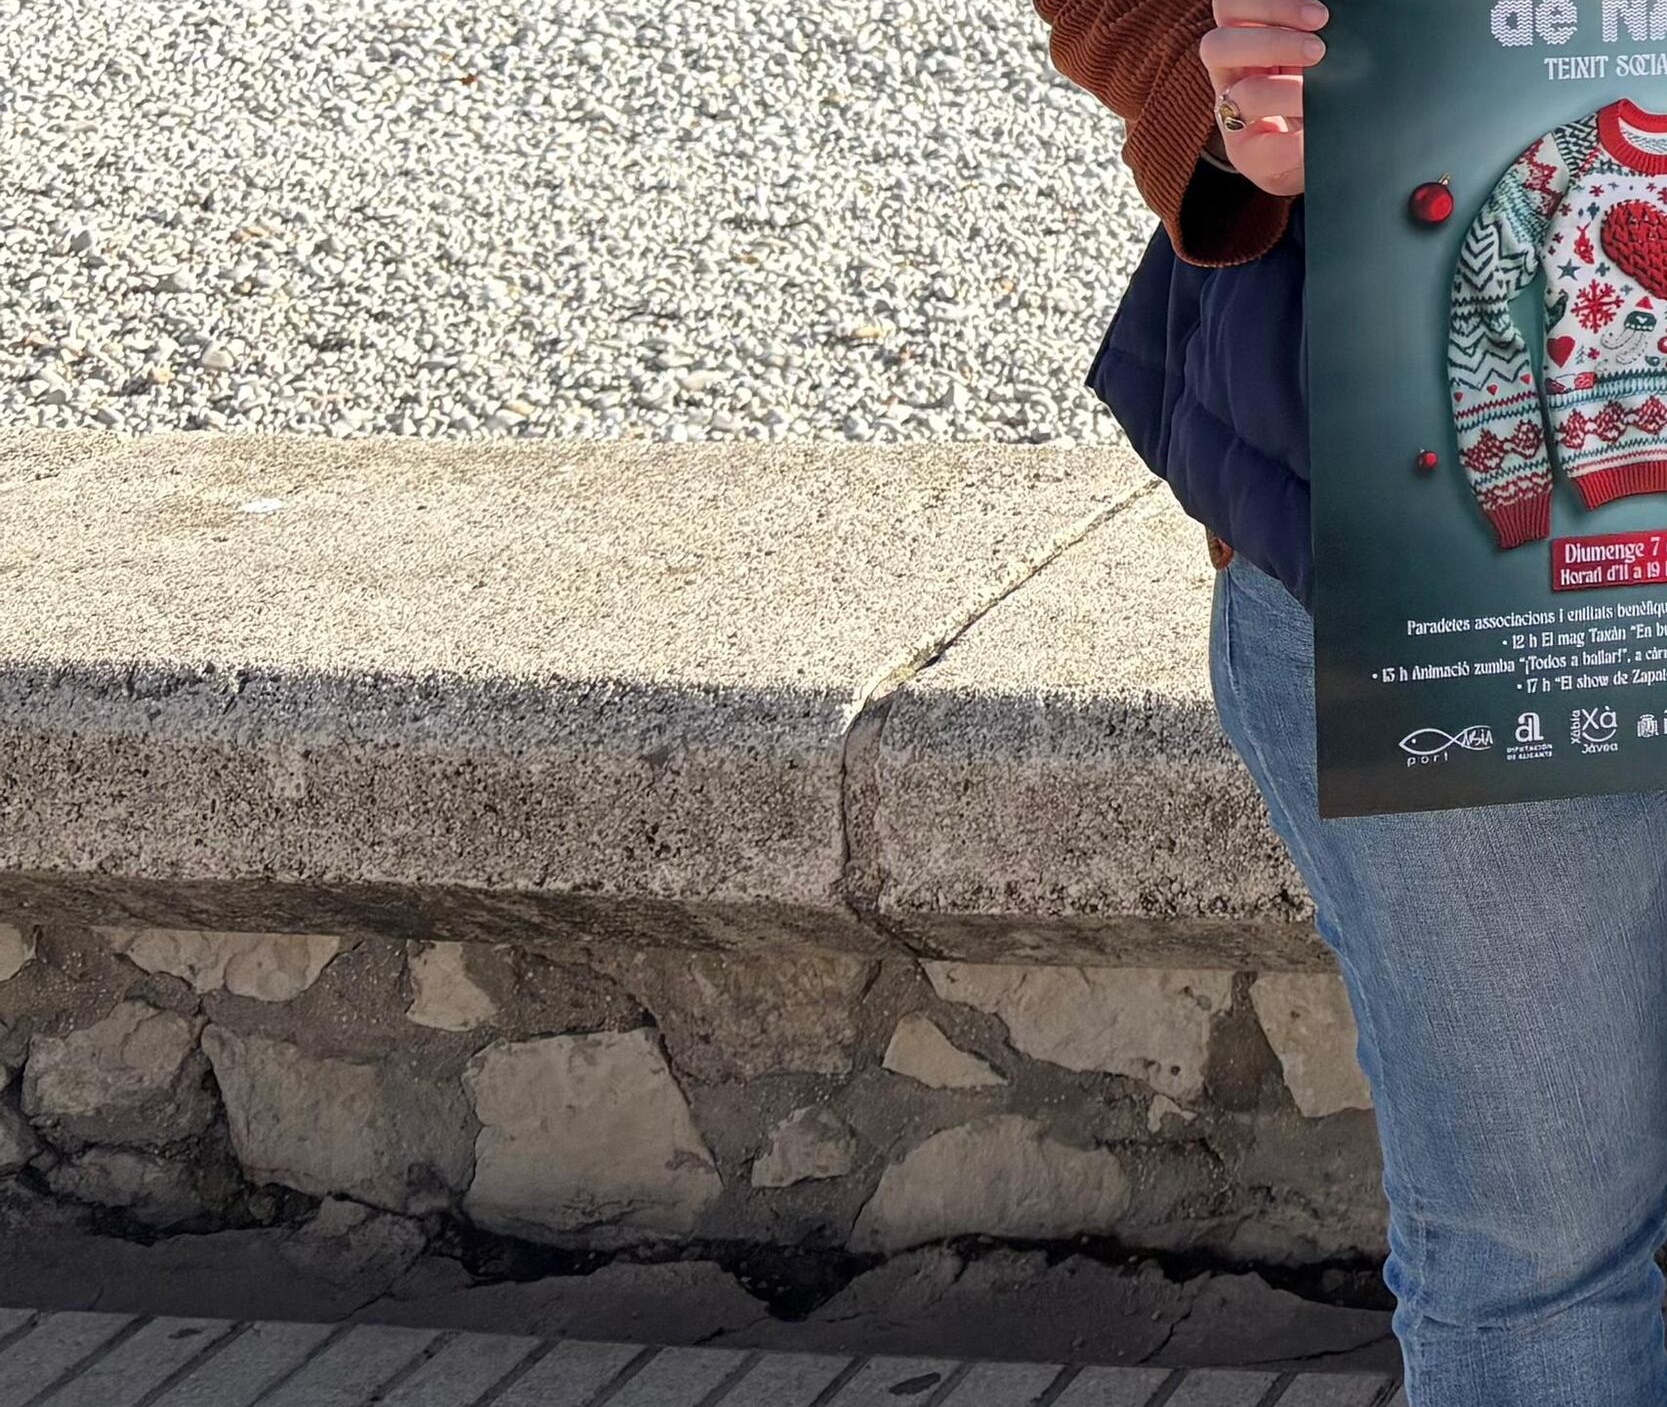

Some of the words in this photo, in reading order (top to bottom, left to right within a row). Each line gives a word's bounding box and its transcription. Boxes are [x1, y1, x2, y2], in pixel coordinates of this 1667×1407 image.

[1544, 55, 1609, 80] TEIXIT
[1564, 542, 1645, 564] Diumenge
[1650, 536, 1661, 556] 7
[1633, 565, 1642, 580] a
[1647, 561, 1660, 578] 19
[1406, 617, 1471, 636] Paradetes
[1475, 610, 1556, 631] associacions
[1567, 604, 1613, 623] entitats
[1512, 634, 1525, 650] 12
[1528, 632, 1538, 648] h
[1541, 631, 1554, 647] El
[1557, 630, 1585, 648] mag
[1399, 666, 1408, 682] h
[1412, 660, 1470, 681] Animació
[1474, 657, 1516, 675] zumba
[1570, 655, 1579, 667] a
[1634, 649, 1642, 661] a
[1526, 678, 1539, 694] 17
[1542, 676, 1551, 692] h
[1576, 672, 1609, 689] show
[1612, 668, 1629, 686] de
[1406, 750, 1449, 768] port
